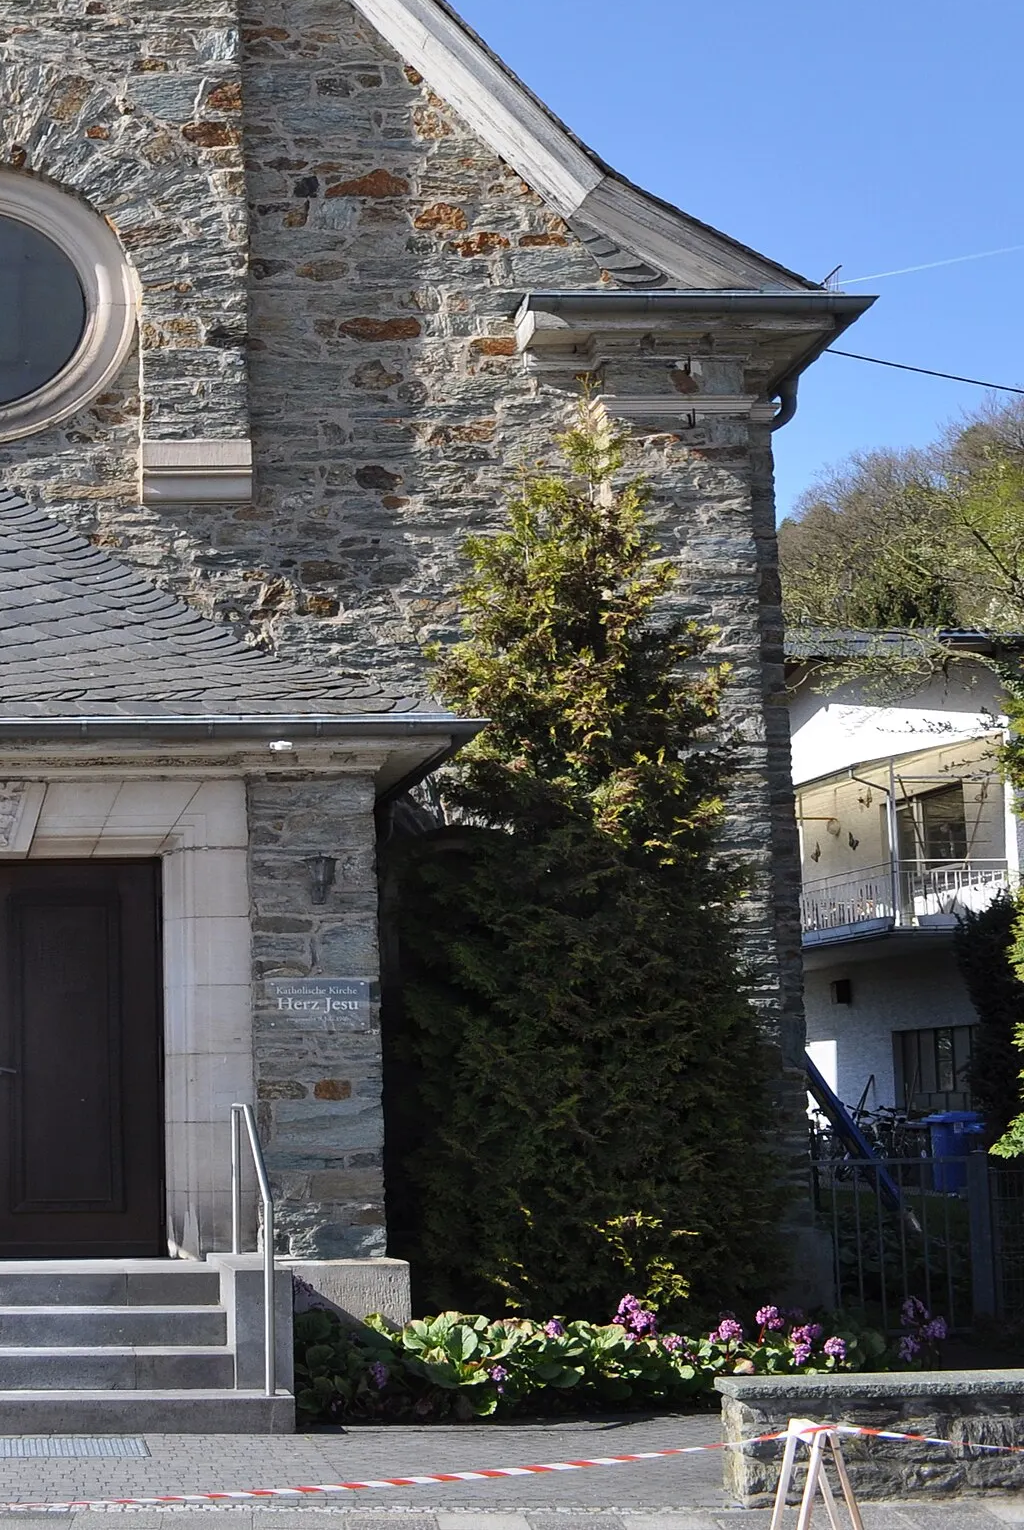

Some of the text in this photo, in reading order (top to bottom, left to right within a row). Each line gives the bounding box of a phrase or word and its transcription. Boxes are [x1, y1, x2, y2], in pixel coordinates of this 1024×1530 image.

[276, 986, 357, 995] Katholische Kirche
[277, 997, 359, 1014] Herz Jesu
